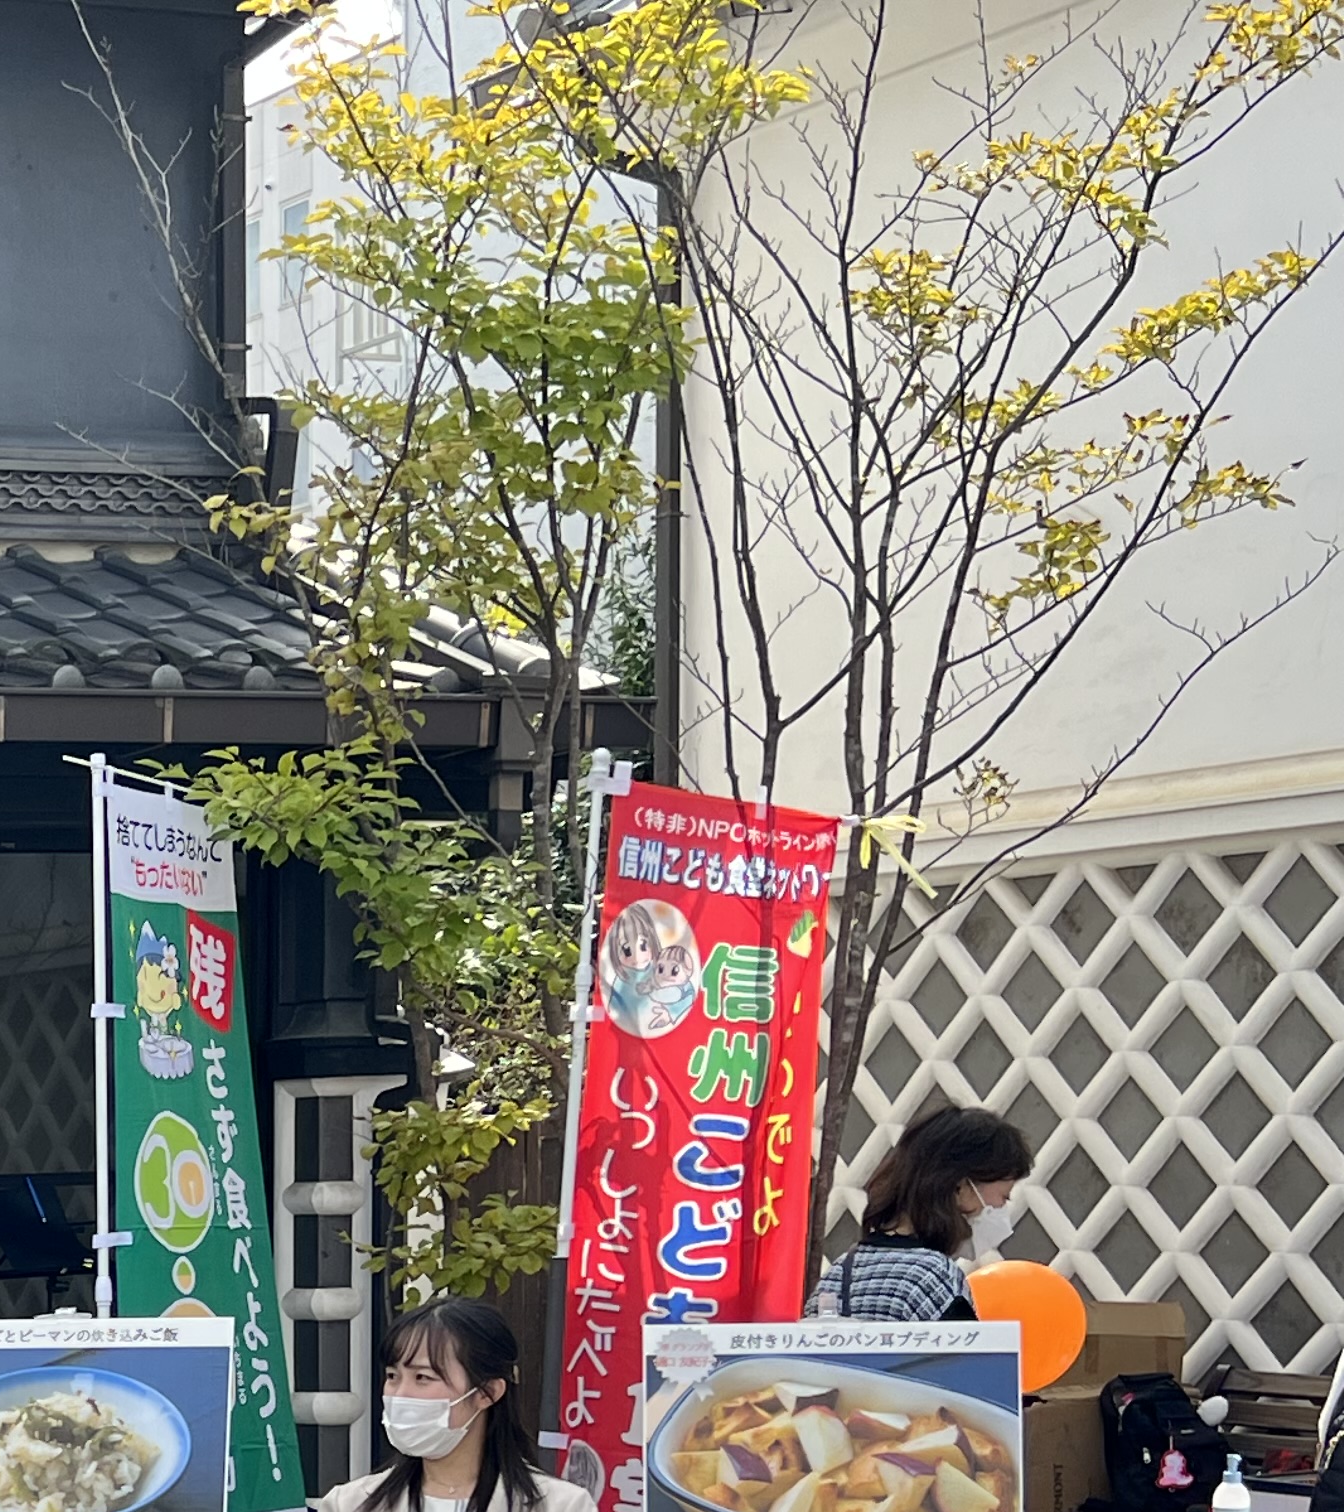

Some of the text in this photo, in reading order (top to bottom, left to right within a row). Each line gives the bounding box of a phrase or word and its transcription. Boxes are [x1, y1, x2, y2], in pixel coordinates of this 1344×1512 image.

[730, 1332, 980, 1349] 皮付きりんごのパン耳プディング
